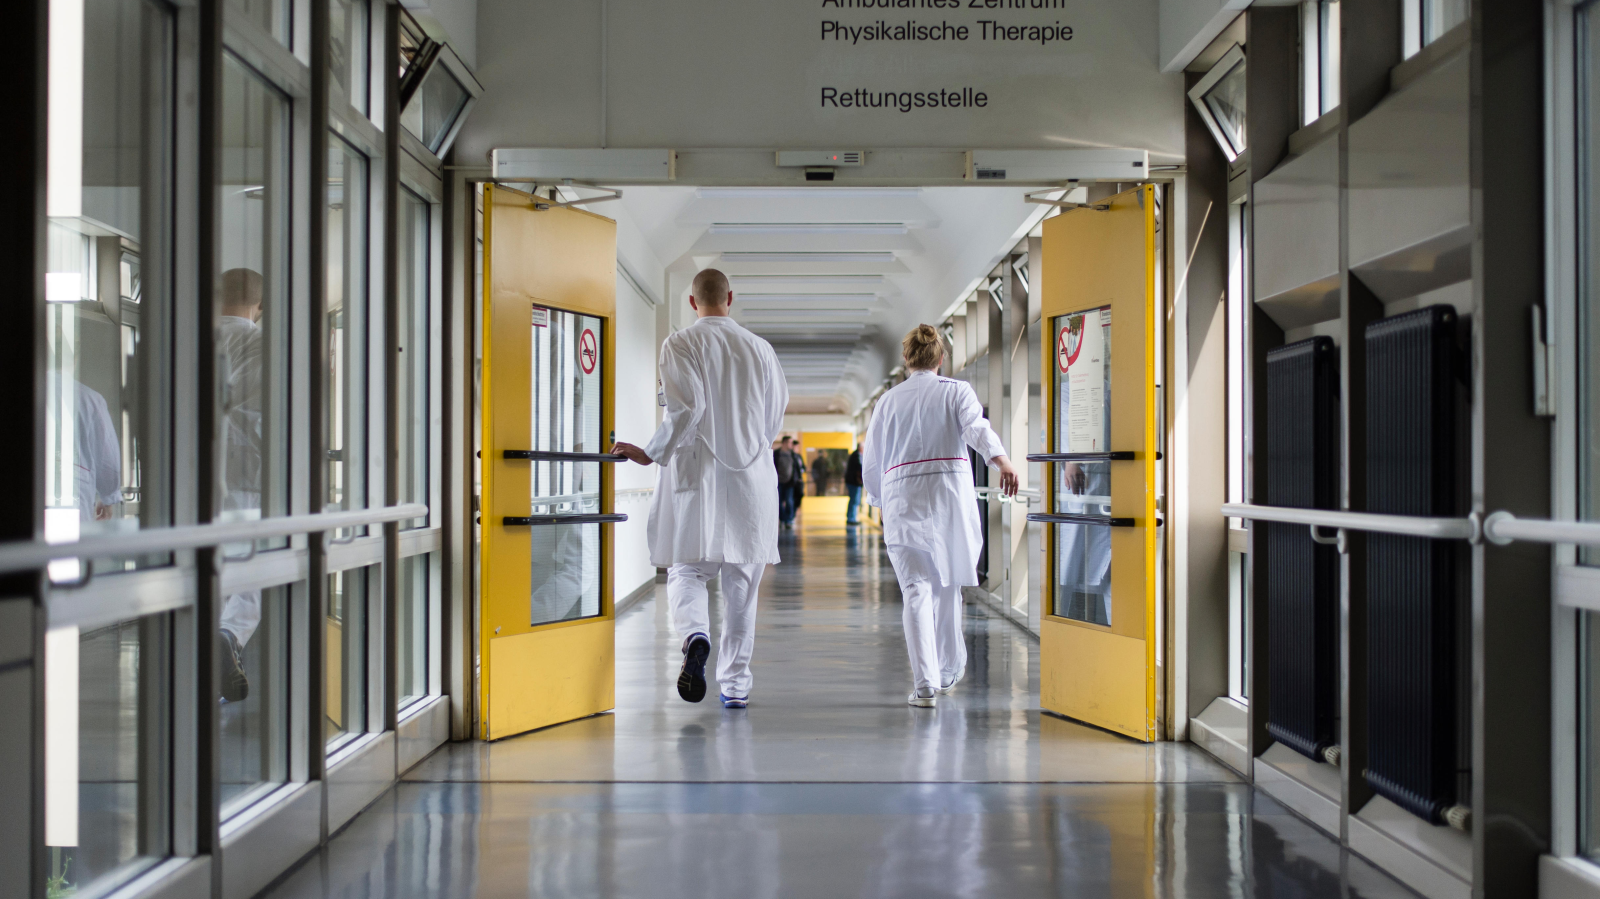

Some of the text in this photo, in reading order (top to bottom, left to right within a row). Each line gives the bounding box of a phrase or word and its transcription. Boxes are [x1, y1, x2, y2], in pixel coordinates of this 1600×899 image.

[821, 20, 1074, 45] Physikalische Therapie
[821, 87, 988, 113] Rettungsstelle
